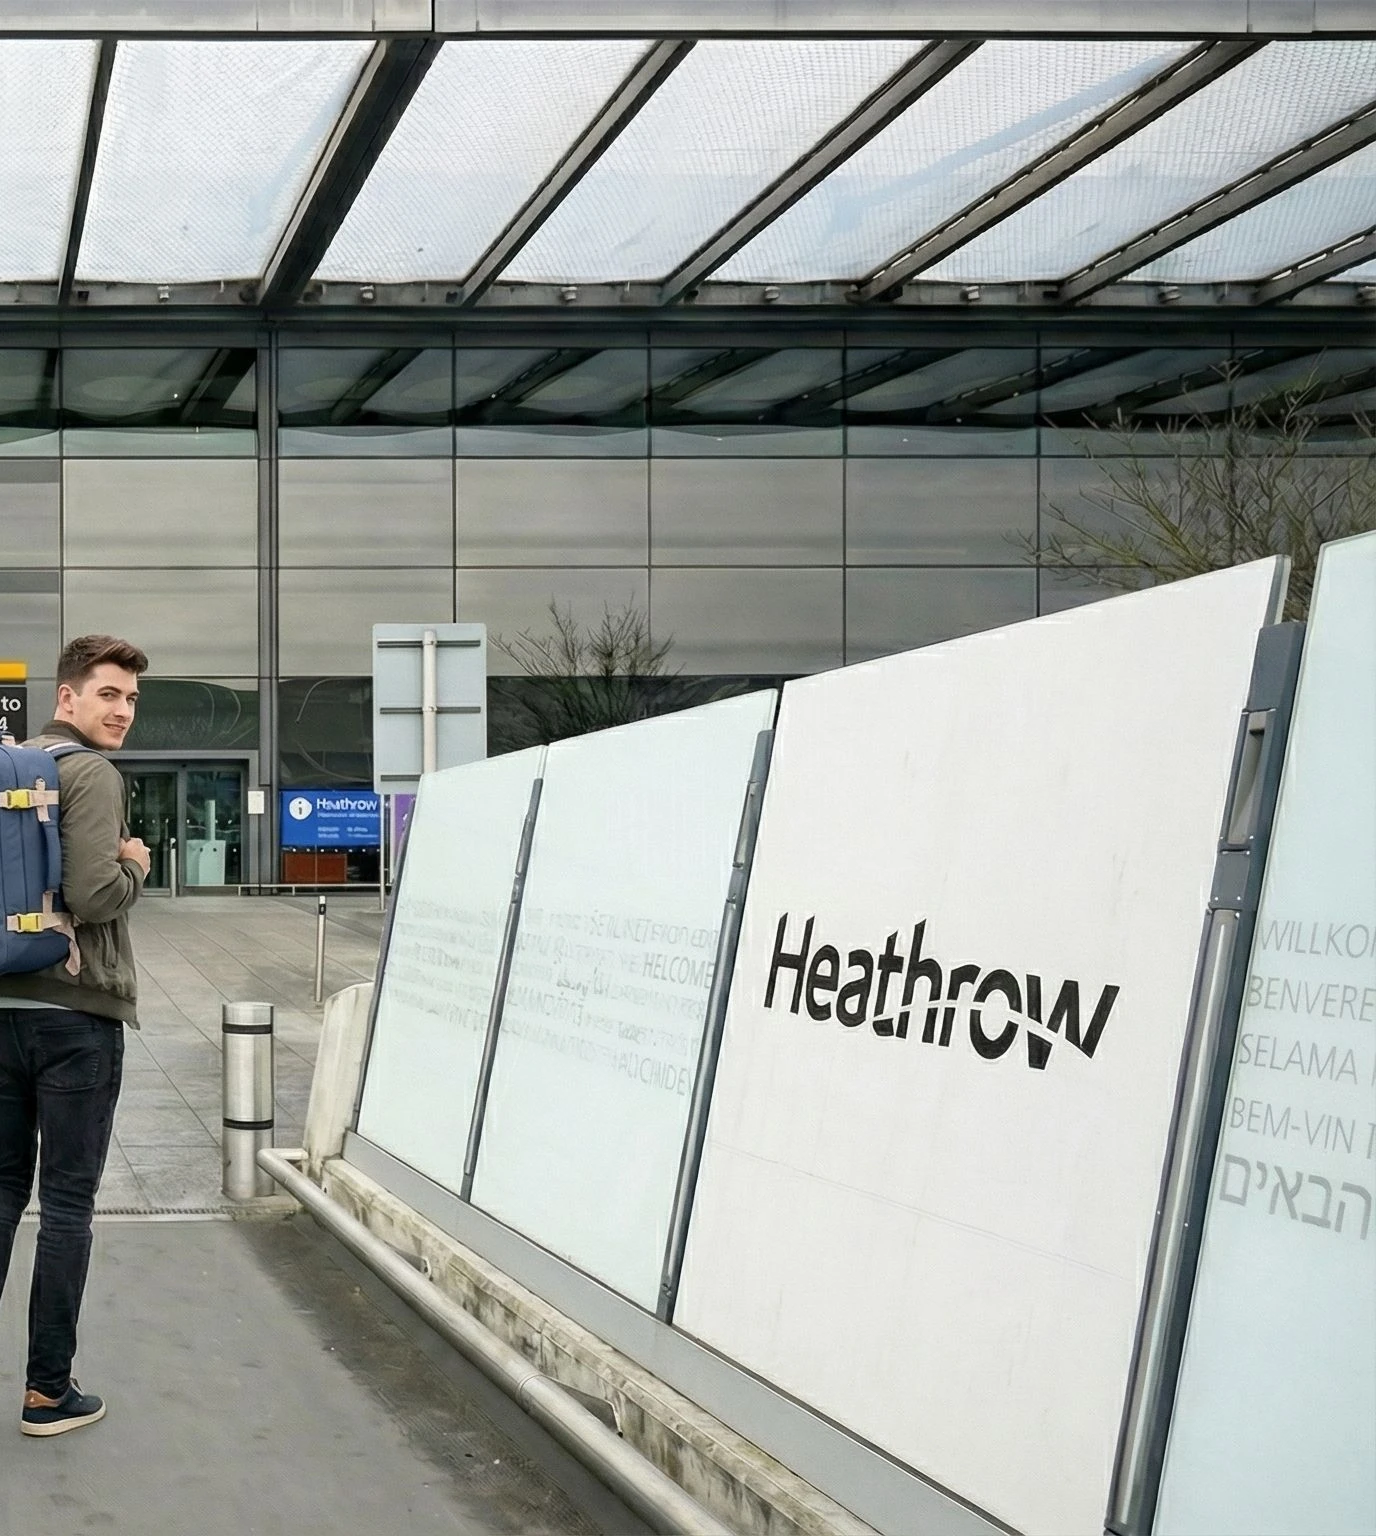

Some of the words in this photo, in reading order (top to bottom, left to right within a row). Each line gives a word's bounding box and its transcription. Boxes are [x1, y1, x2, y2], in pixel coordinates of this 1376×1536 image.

[0, 696, 22, 712] to
[1261, 919, 1376, 959] WILLKO
[763, 912, 1120, 1071] Heathrow
[1238, 1032, 1358, 1086] SELAMA
[1229, 1096, 1356, 1155] BEM-VIN
[1219, 1153, 1373, 1241] הבאים
